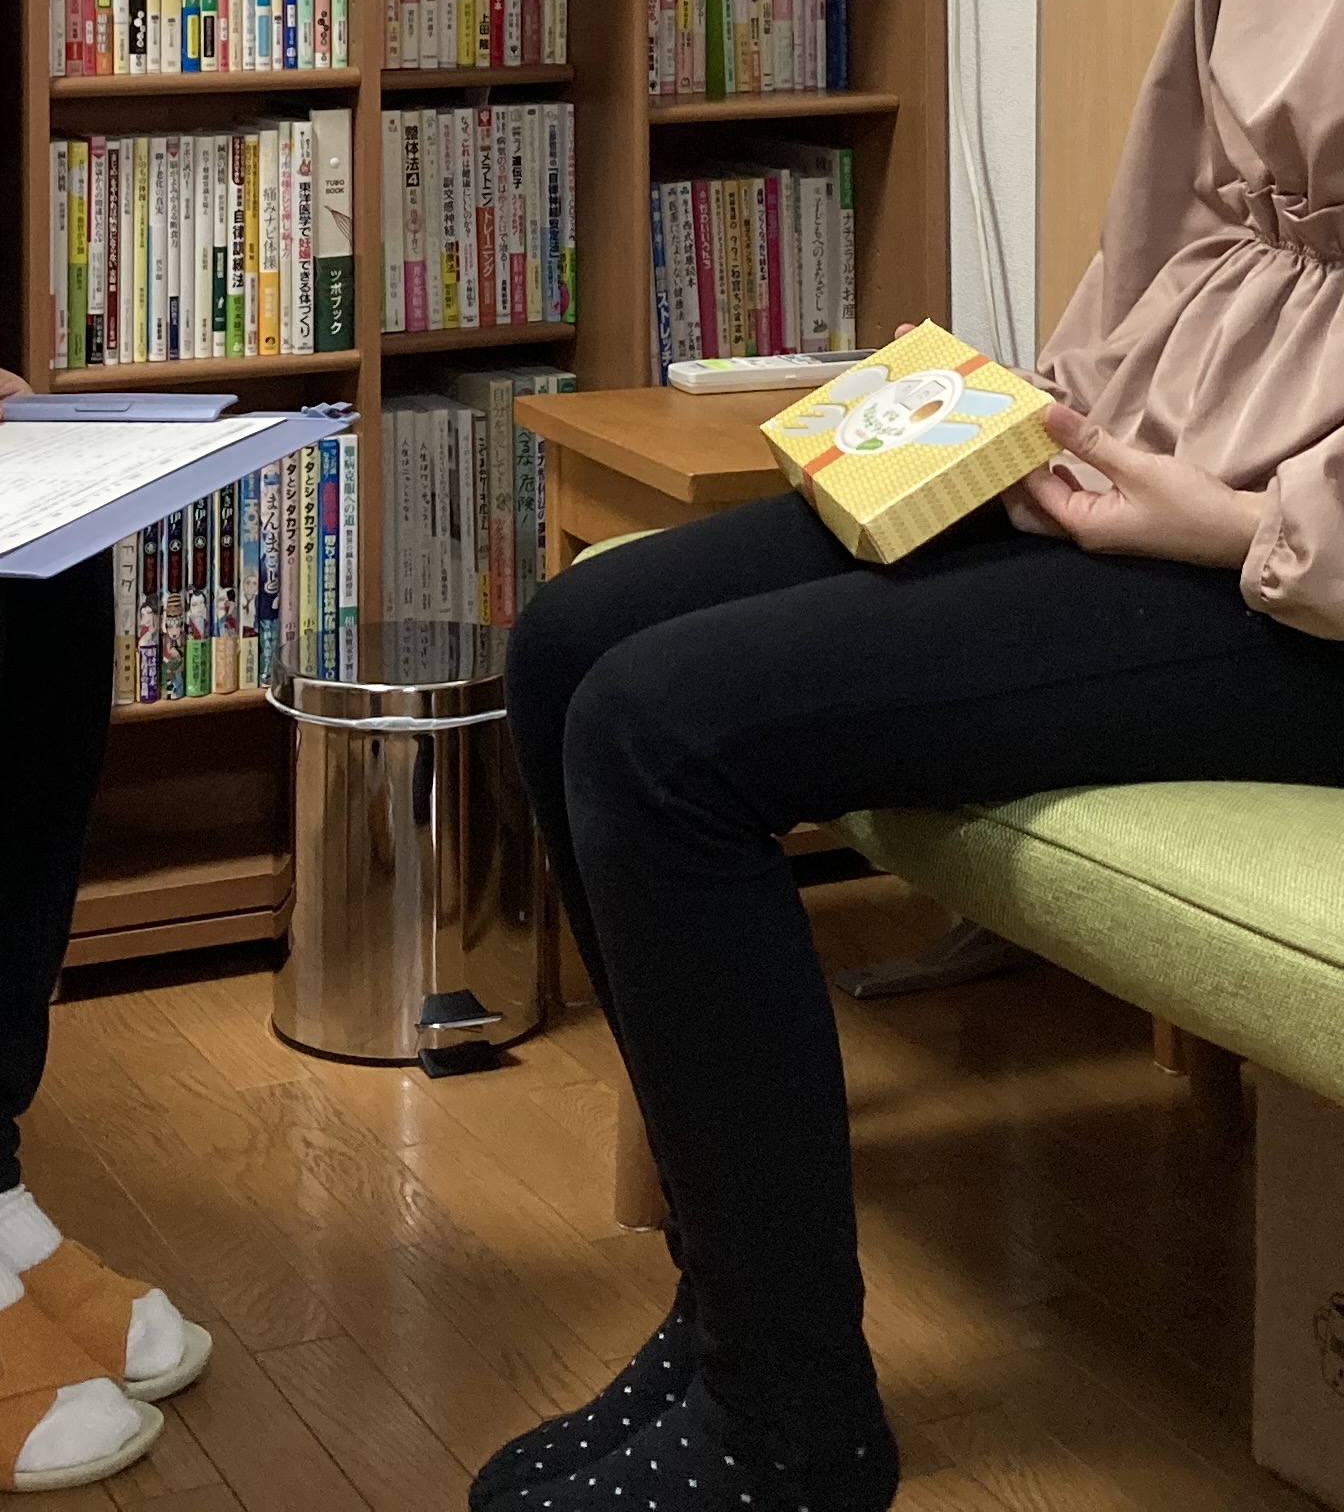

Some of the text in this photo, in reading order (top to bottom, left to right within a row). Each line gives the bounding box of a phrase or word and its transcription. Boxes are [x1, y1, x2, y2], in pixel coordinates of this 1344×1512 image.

[480, 151, 492, 206] メラトニン
[263, 186, 278, 270] 痛みナビ体操
[482, 210, 494, 277] トレーニング
[842, 213, 855, 320] ナチュラルなお産
[263, 492, 280, 594] まんまこと
